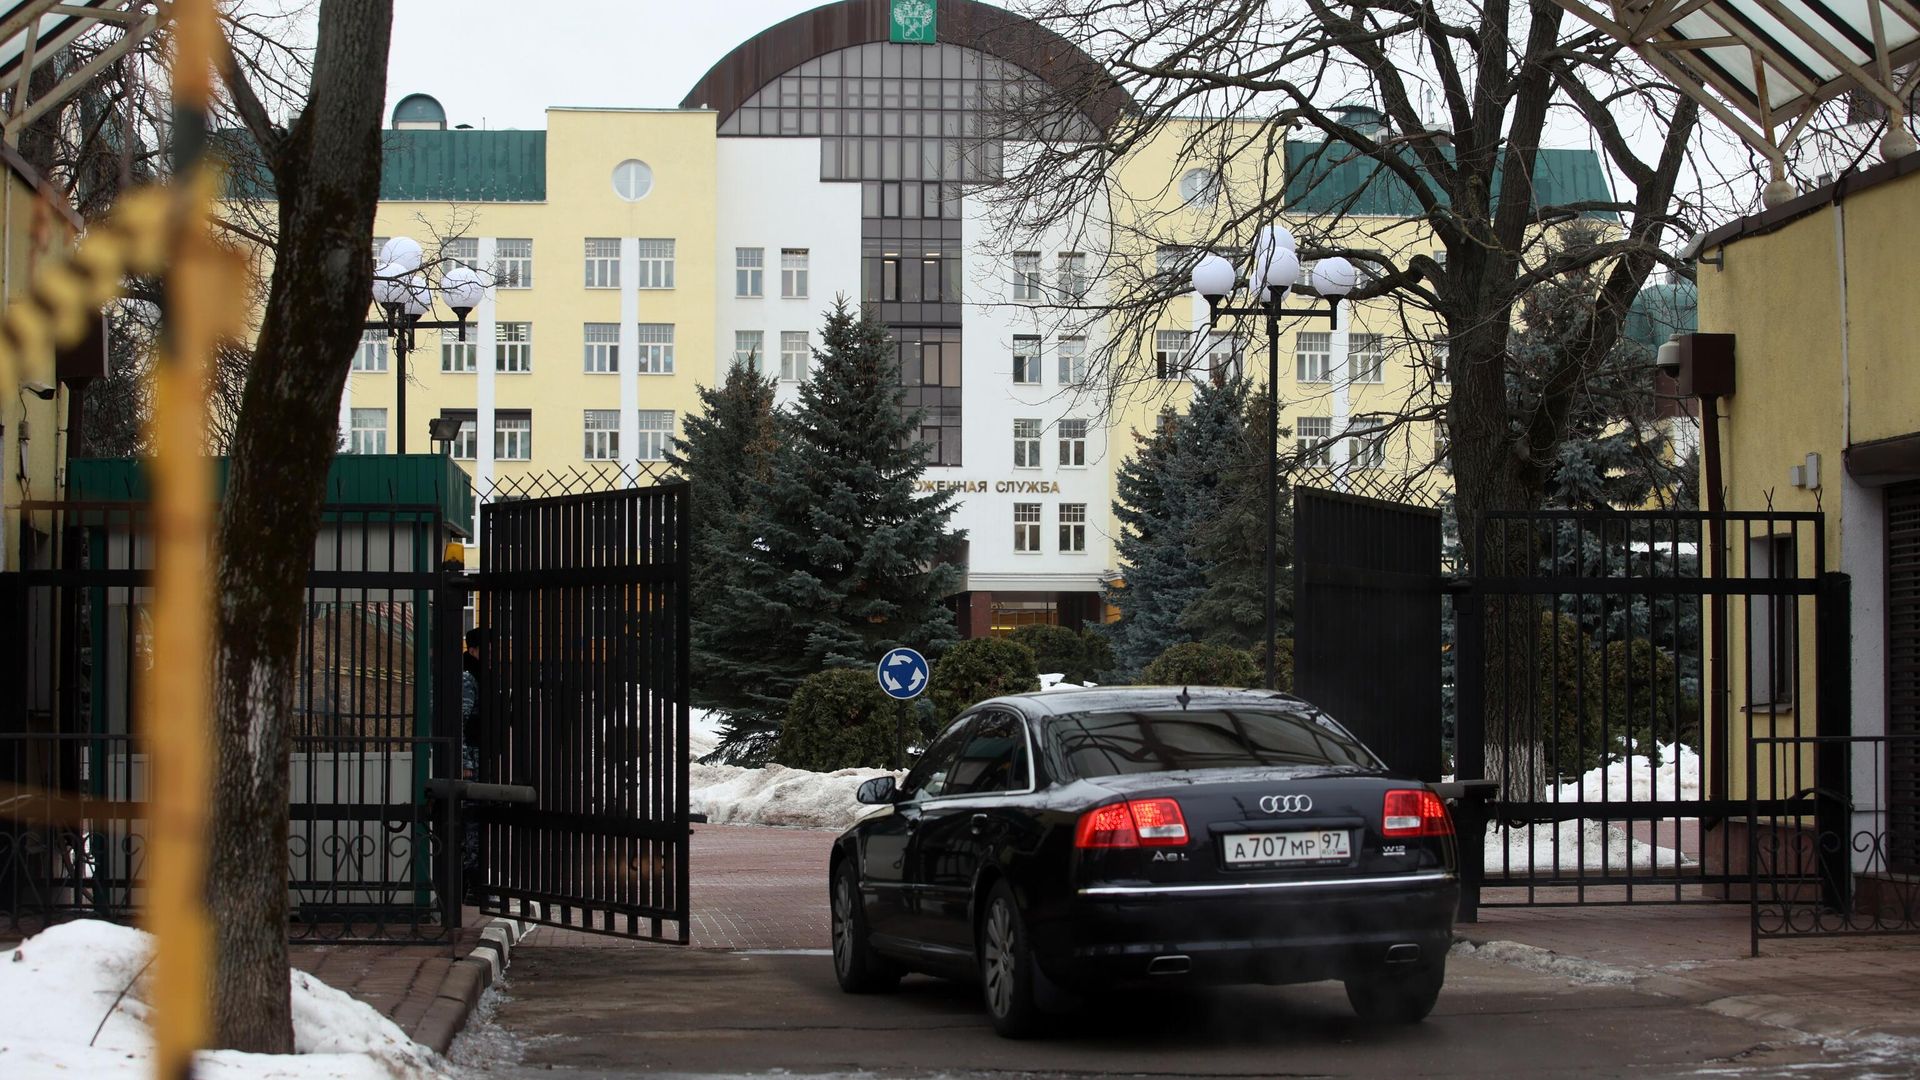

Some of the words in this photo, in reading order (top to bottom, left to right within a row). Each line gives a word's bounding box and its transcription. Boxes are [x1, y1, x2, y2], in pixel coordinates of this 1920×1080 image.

[912, 480, 987, 493] ОЖЕННАЯ
[995, 480, 1060, 493] СЛУЖБА
[1321, 833, 1341, 849] 97
